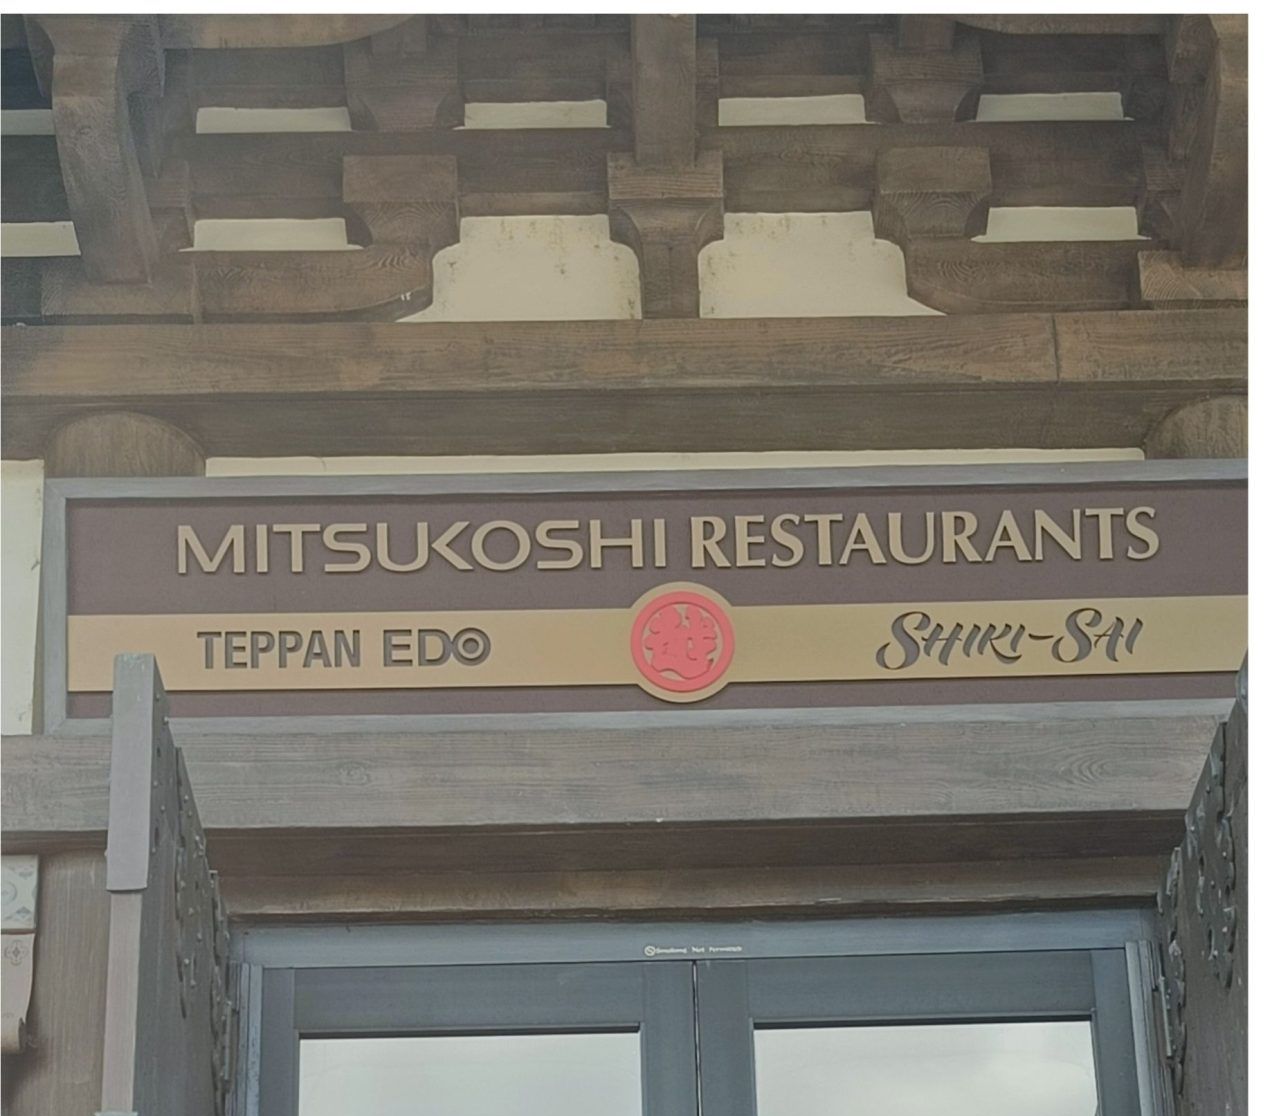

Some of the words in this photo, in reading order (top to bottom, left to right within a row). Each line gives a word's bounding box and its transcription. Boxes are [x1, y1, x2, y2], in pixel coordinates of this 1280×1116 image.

[177, 518, 667, 575] MITSUKOSHI
[690, 506, 1161, 569] RESTAURANTS
[196, 629, 362, 669] TEPPAN
[383, 627, 492, 669] EDO
